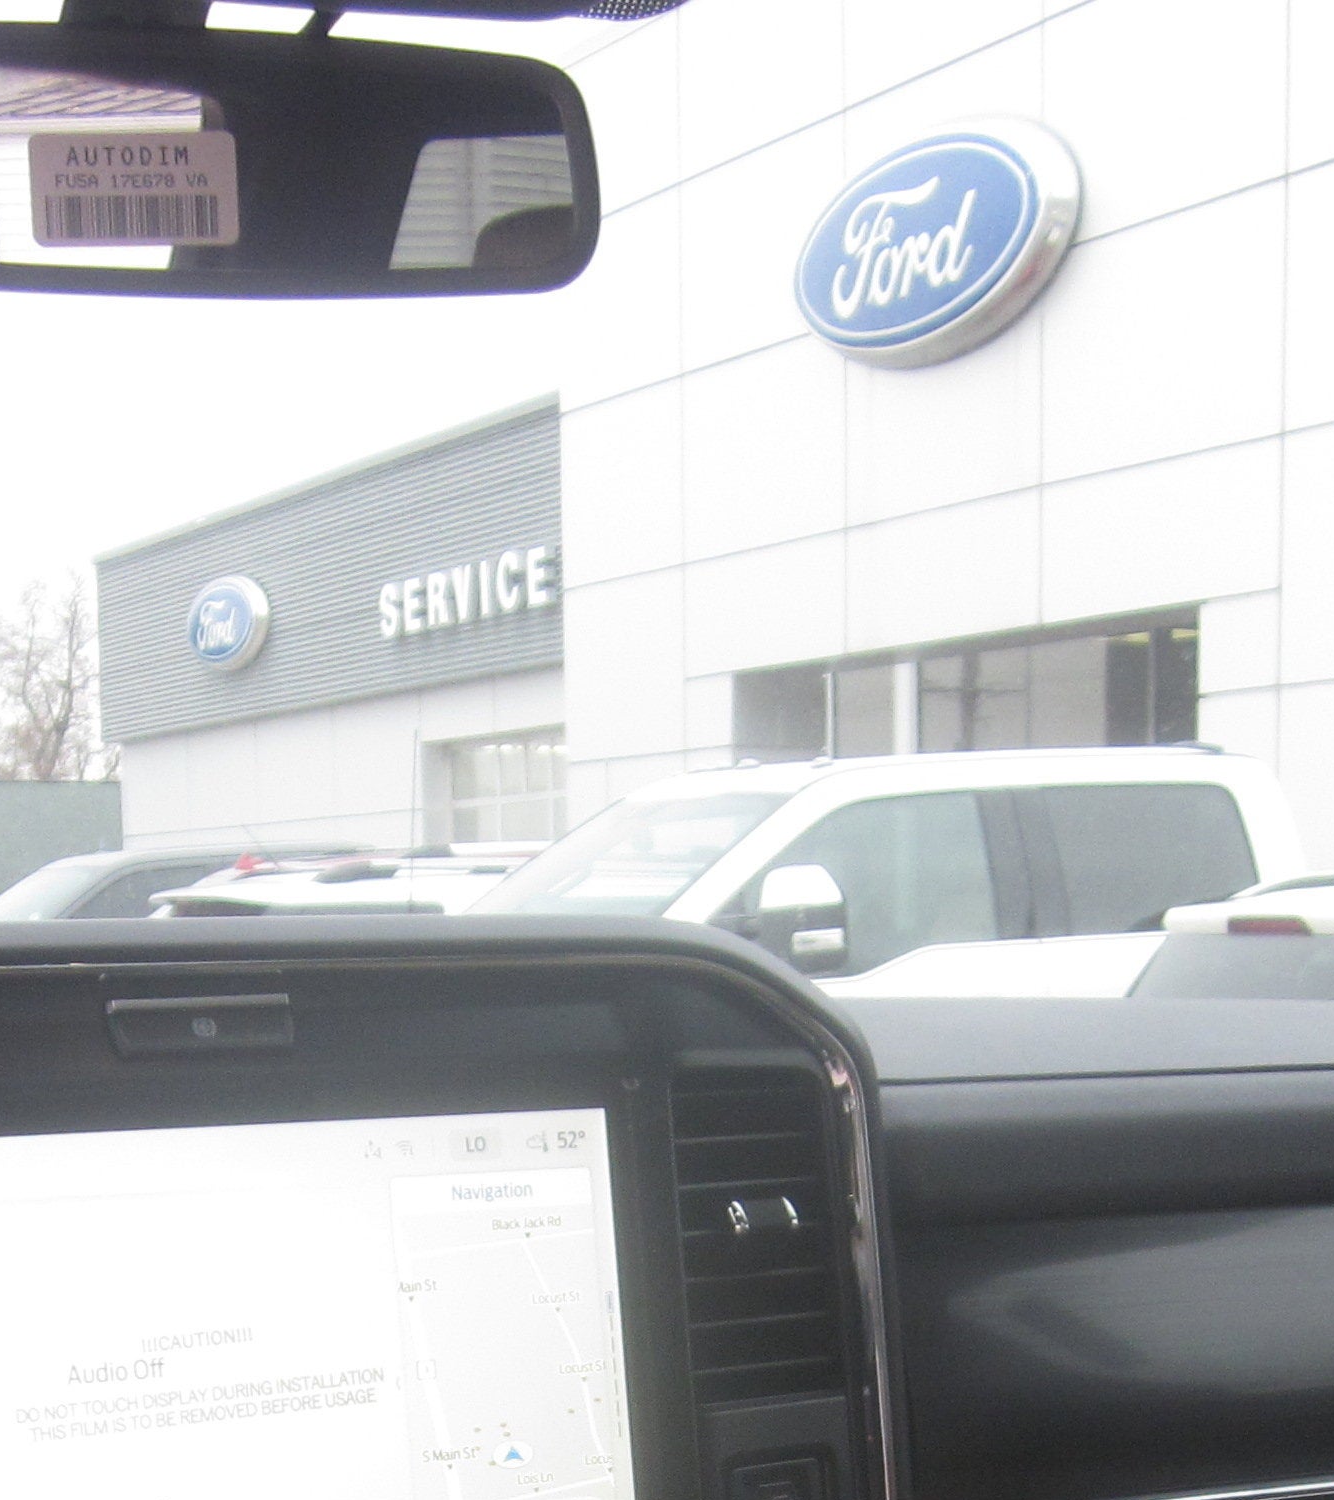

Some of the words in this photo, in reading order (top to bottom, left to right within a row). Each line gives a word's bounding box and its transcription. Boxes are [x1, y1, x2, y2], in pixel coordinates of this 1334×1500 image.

[67, 146, 189, 166] AUTODIM
[111, 174, 175, 189] 17E678
[186, 173, 208, 188] VA
[832, 176, 977, 321] Ford
[379, 546, 548, 638] SERVICE
[196, 600, 236, 650] Ford
[465, 1136, 487, 1153] LO
[451, 1182, 533, 1202] Navigation
[491, 1217, 520, 1231] Black
[523, 1216, 545, 1229] Jack
[547, 1215, 562, 1227] Rd
[424, 1279, 437, 1291] St
[532, 1293, 564, 1305] Locust
[567, 1291, 580, 1302] St
[67, 1360, 128, 1385] Audio
[134, 1358, 165, 1380] Off
[16, 1407, 40, 1424] DO
[44, 1402, 80, 1421] NOT
[84, 1396, 138, 1416] TOUCH
[143, 1388, 207, 1410] DISPLAY
[212, 1380, 273, 1401] DURING
[276, 1367, 385, 1394] INSTALLATION
[29, 1424, 66, 1443] THIS
[70, 1420, 108, 1438] FILM
[113, 1417, 127, 1434] IS
[131, 1414, 152, 1431] TO
[155, 1411, 177, 1429] BE
[180, 1403, 257, 1425] REMOVED
[261, 1395, 322, 1416] BEFORE
[326, 1387, 378, 1408] USAGE
[433, 1448, 460, 1462] Main
